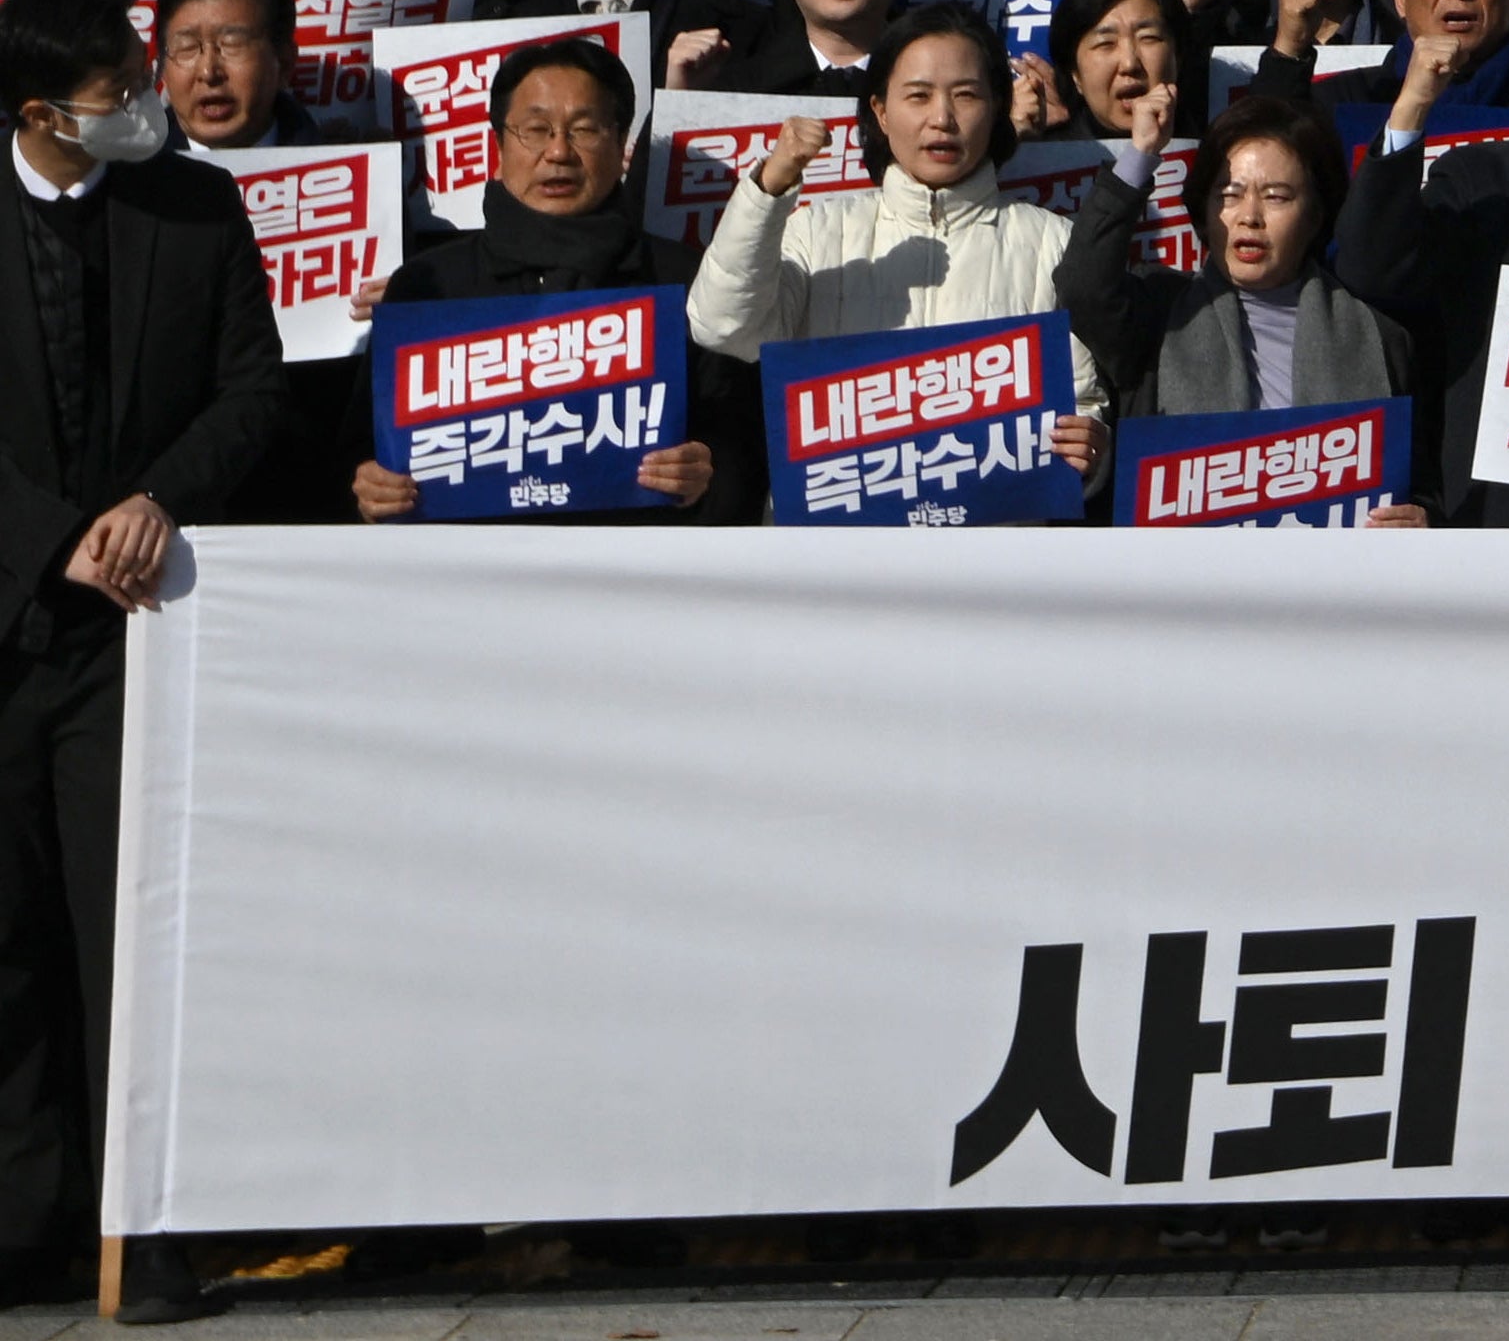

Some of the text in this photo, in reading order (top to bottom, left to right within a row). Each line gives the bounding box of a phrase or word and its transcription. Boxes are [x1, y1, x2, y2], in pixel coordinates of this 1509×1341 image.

[408, 307, 643, 412] 내란행위
[799, 336, 1031, 447] 내란행위
[409, 382, 666, 485] 즉각수사!
[805, 409, 1065, 513] 즉각수사!
[1148, 420, 1373, 520] 내란행위
[948, 913, 1477, 1187] 사퇴
